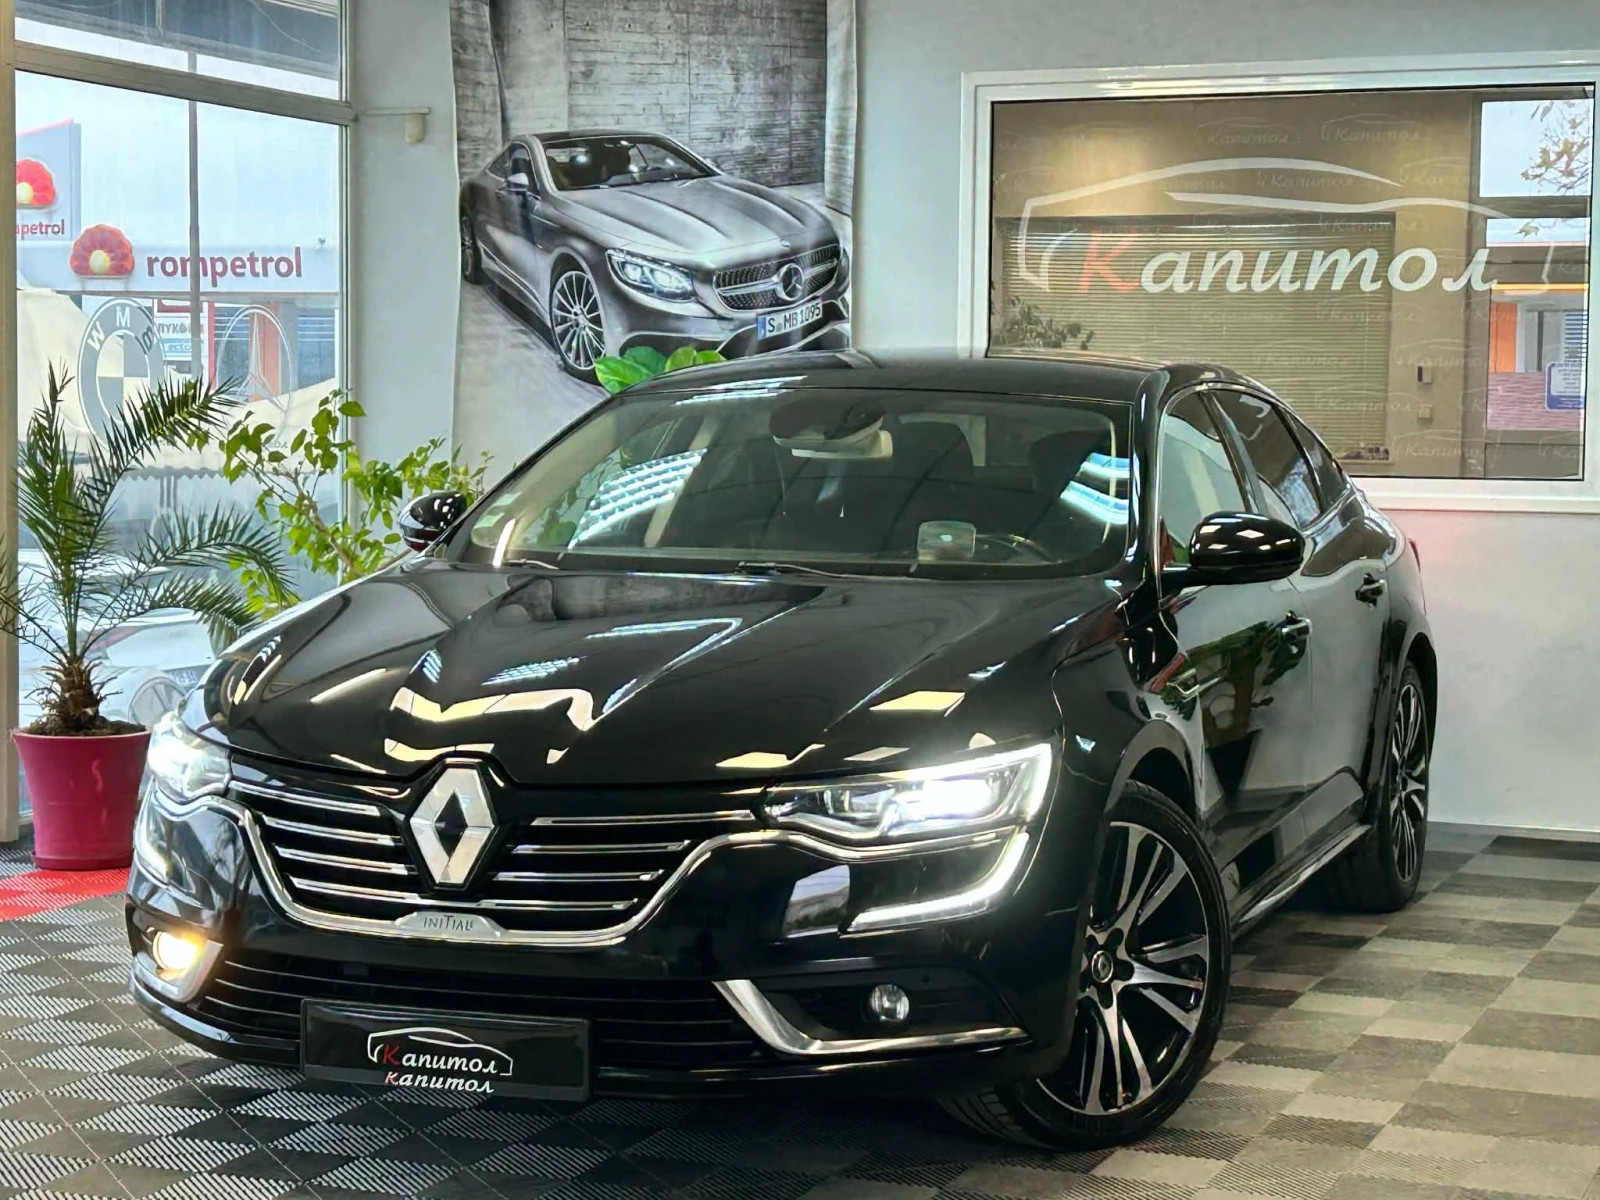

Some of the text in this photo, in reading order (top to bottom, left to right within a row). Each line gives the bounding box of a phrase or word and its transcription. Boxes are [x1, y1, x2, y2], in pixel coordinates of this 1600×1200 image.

[147, 247, 302, 287] rompetrol
[1077, 228, 1498, 293] Капитол
[783, 313, 798, 330] MB
[381, 1044, 498, 1074] Капитол
